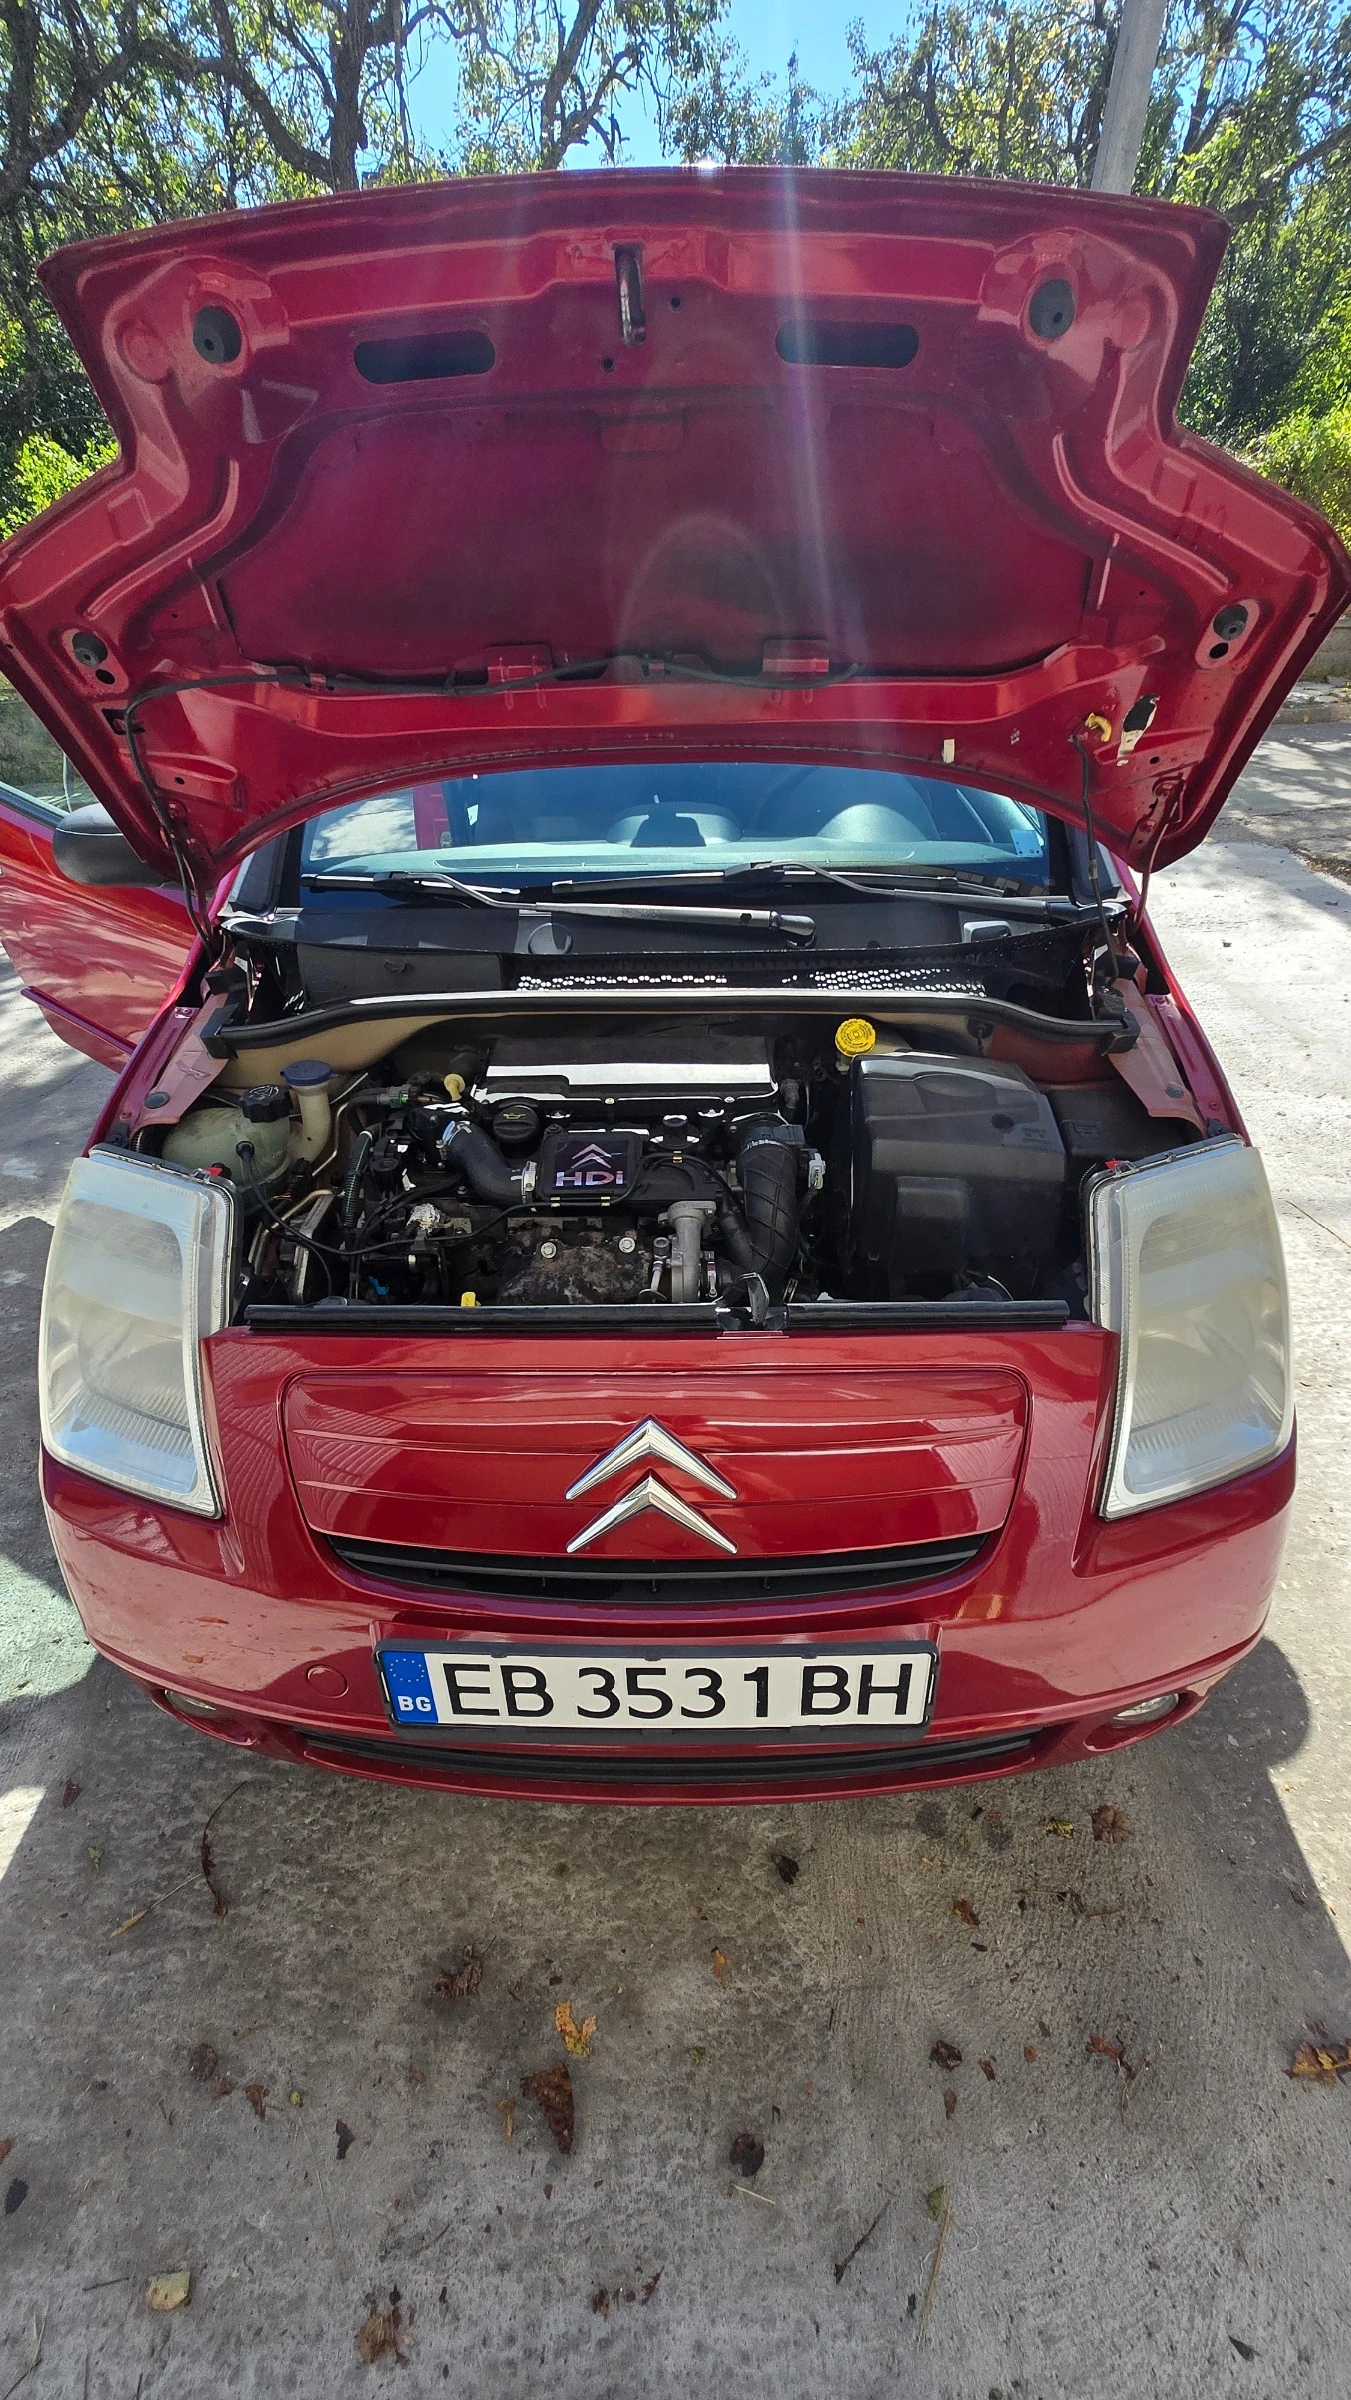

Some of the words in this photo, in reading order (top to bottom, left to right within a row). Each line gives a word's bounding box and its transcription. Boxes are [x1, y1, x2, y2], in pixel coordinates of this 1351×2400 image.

[555, 1170, 624, 1187] HDi
[442, 1662, 554, 1718] EB
[576, 1666, 769, 1720] 3531
[800, 1663, 913, 1716] BH
[397, 1695, 432, 1712] BG
